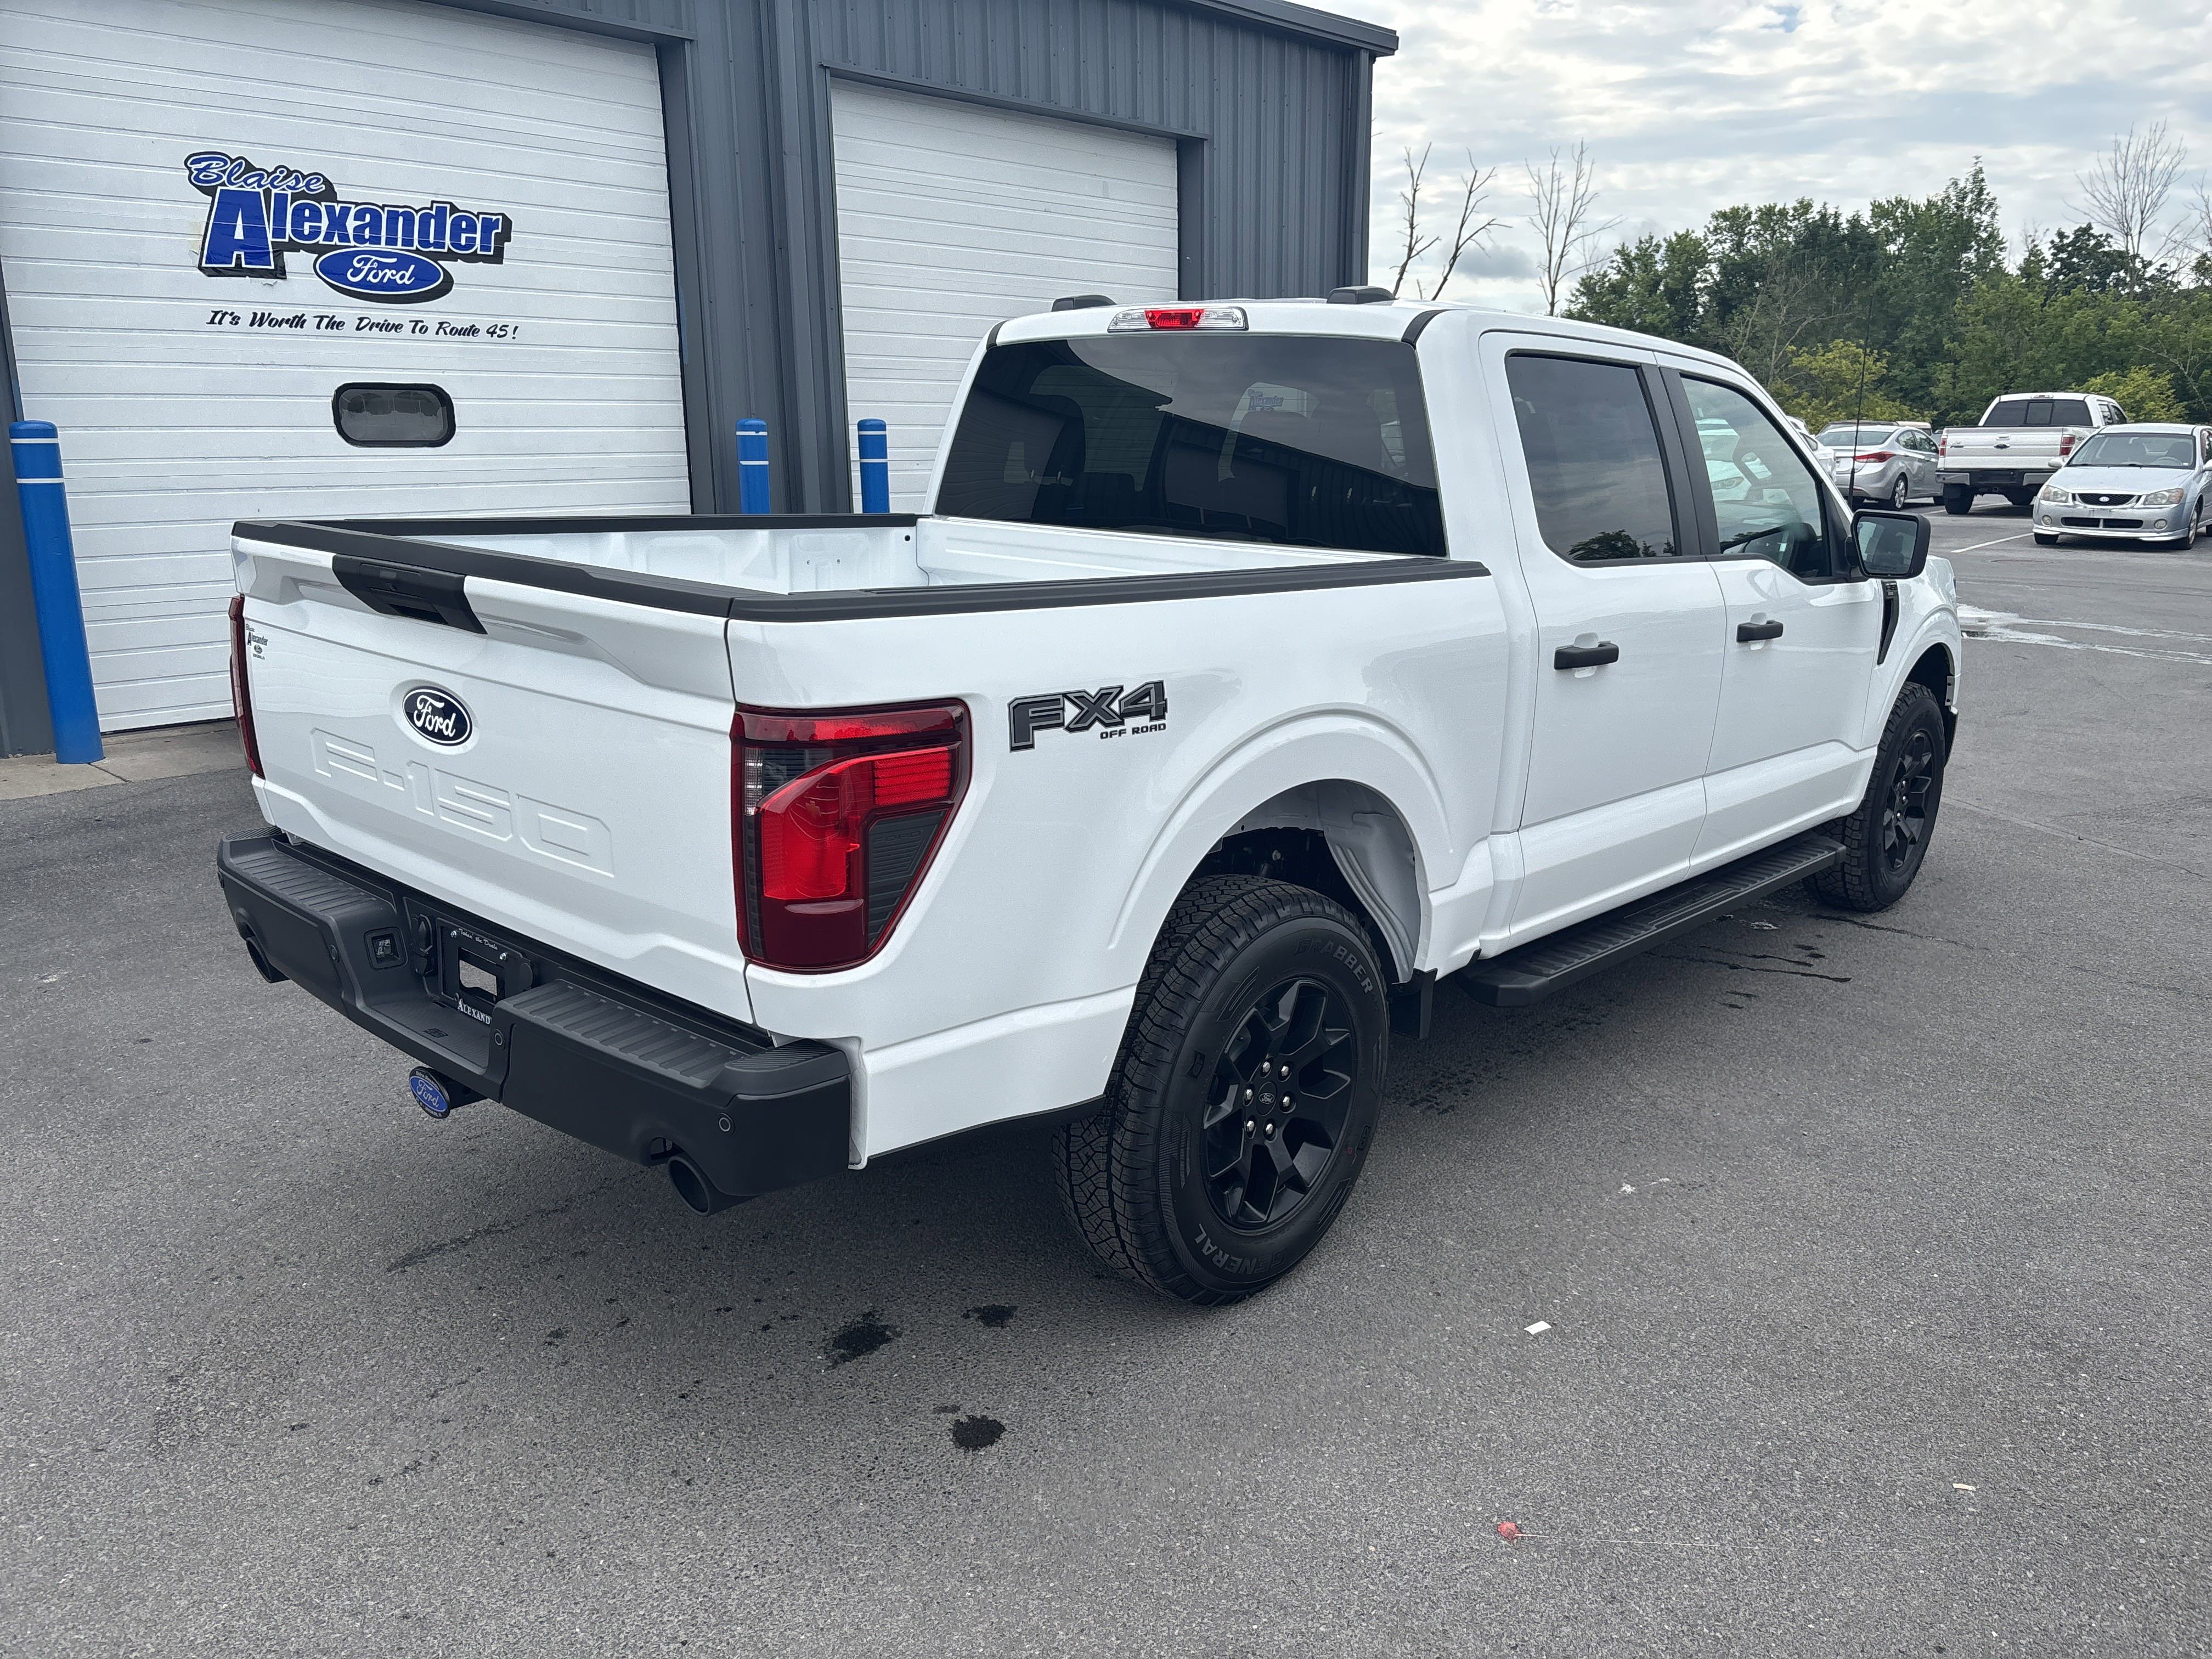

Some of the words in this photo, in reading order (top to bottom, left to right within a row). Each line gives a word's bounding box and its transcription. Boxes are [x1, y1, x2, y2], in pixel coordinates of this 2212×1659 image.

[187, 154, 325, 194] Blaise
[201, 186, 503, 269] Alexander
[347, 254, 415, 285] Ford
[206, 309, 241, 326] It's
[249, 312, 307, 329] Worth
[313, 314, 346, 330] The
[356, 317, 404, 334] Drive
[409, 320, 428, 335] To
[435, 321, 481, 337] Route
[413, 695, 456, 737] Ford
[1007, 680, 1167, 753] FX4
[1100, 728, 1127, 740] OFF
[1132, 723, 1167, 736] ROAD
[310, 727, 615, 878] F-150
[1295, 939, 1373, 994] GRABBER
[457, 998, 492, 1025] ALEXAND
[417, 1079, 439, 1108] Ford
[1194, 1223, 1286, 1274] GENERAL
